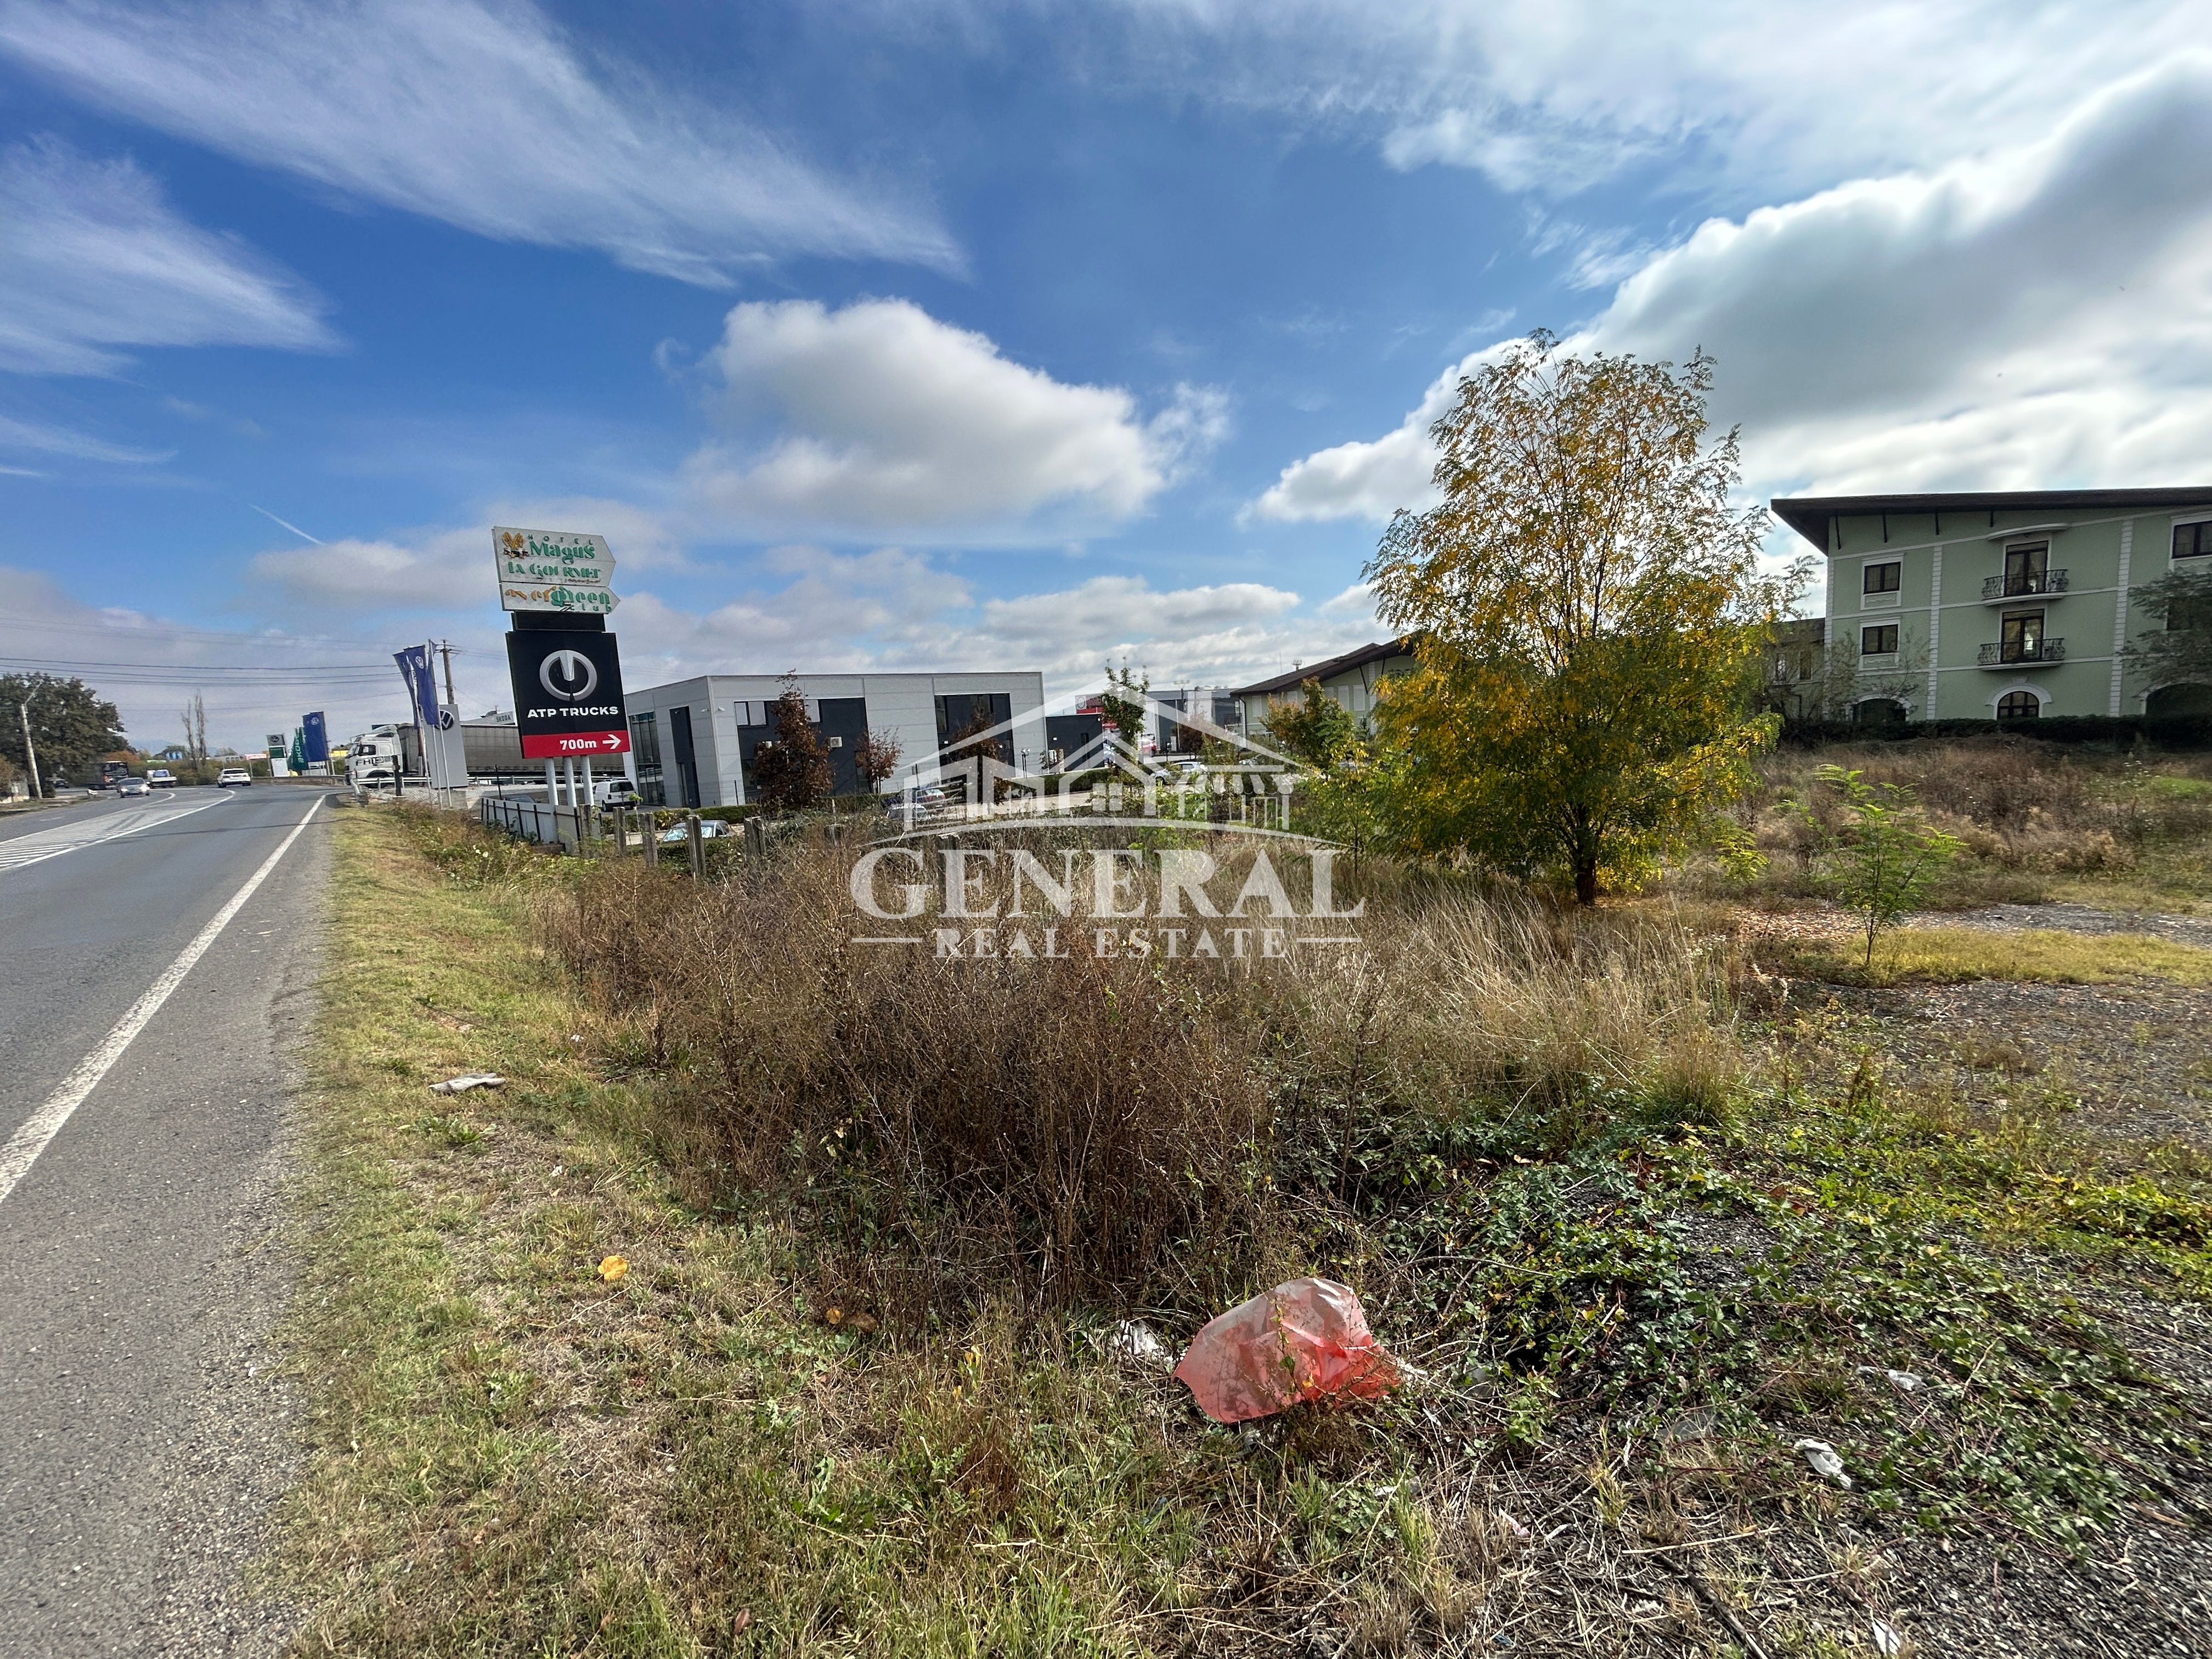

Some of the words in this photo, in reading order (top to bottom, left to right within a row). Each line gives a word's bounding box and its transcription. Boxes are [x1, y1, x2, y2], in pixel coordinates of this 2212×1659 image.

[528, 534, 593, 545] HOTEL
[529, 540, 595, 565] Magus
[527, 708, 556, 718] ATP
[560, 706, 618, 716] TRUCKS
[560, 739, 596, 750] 700m
